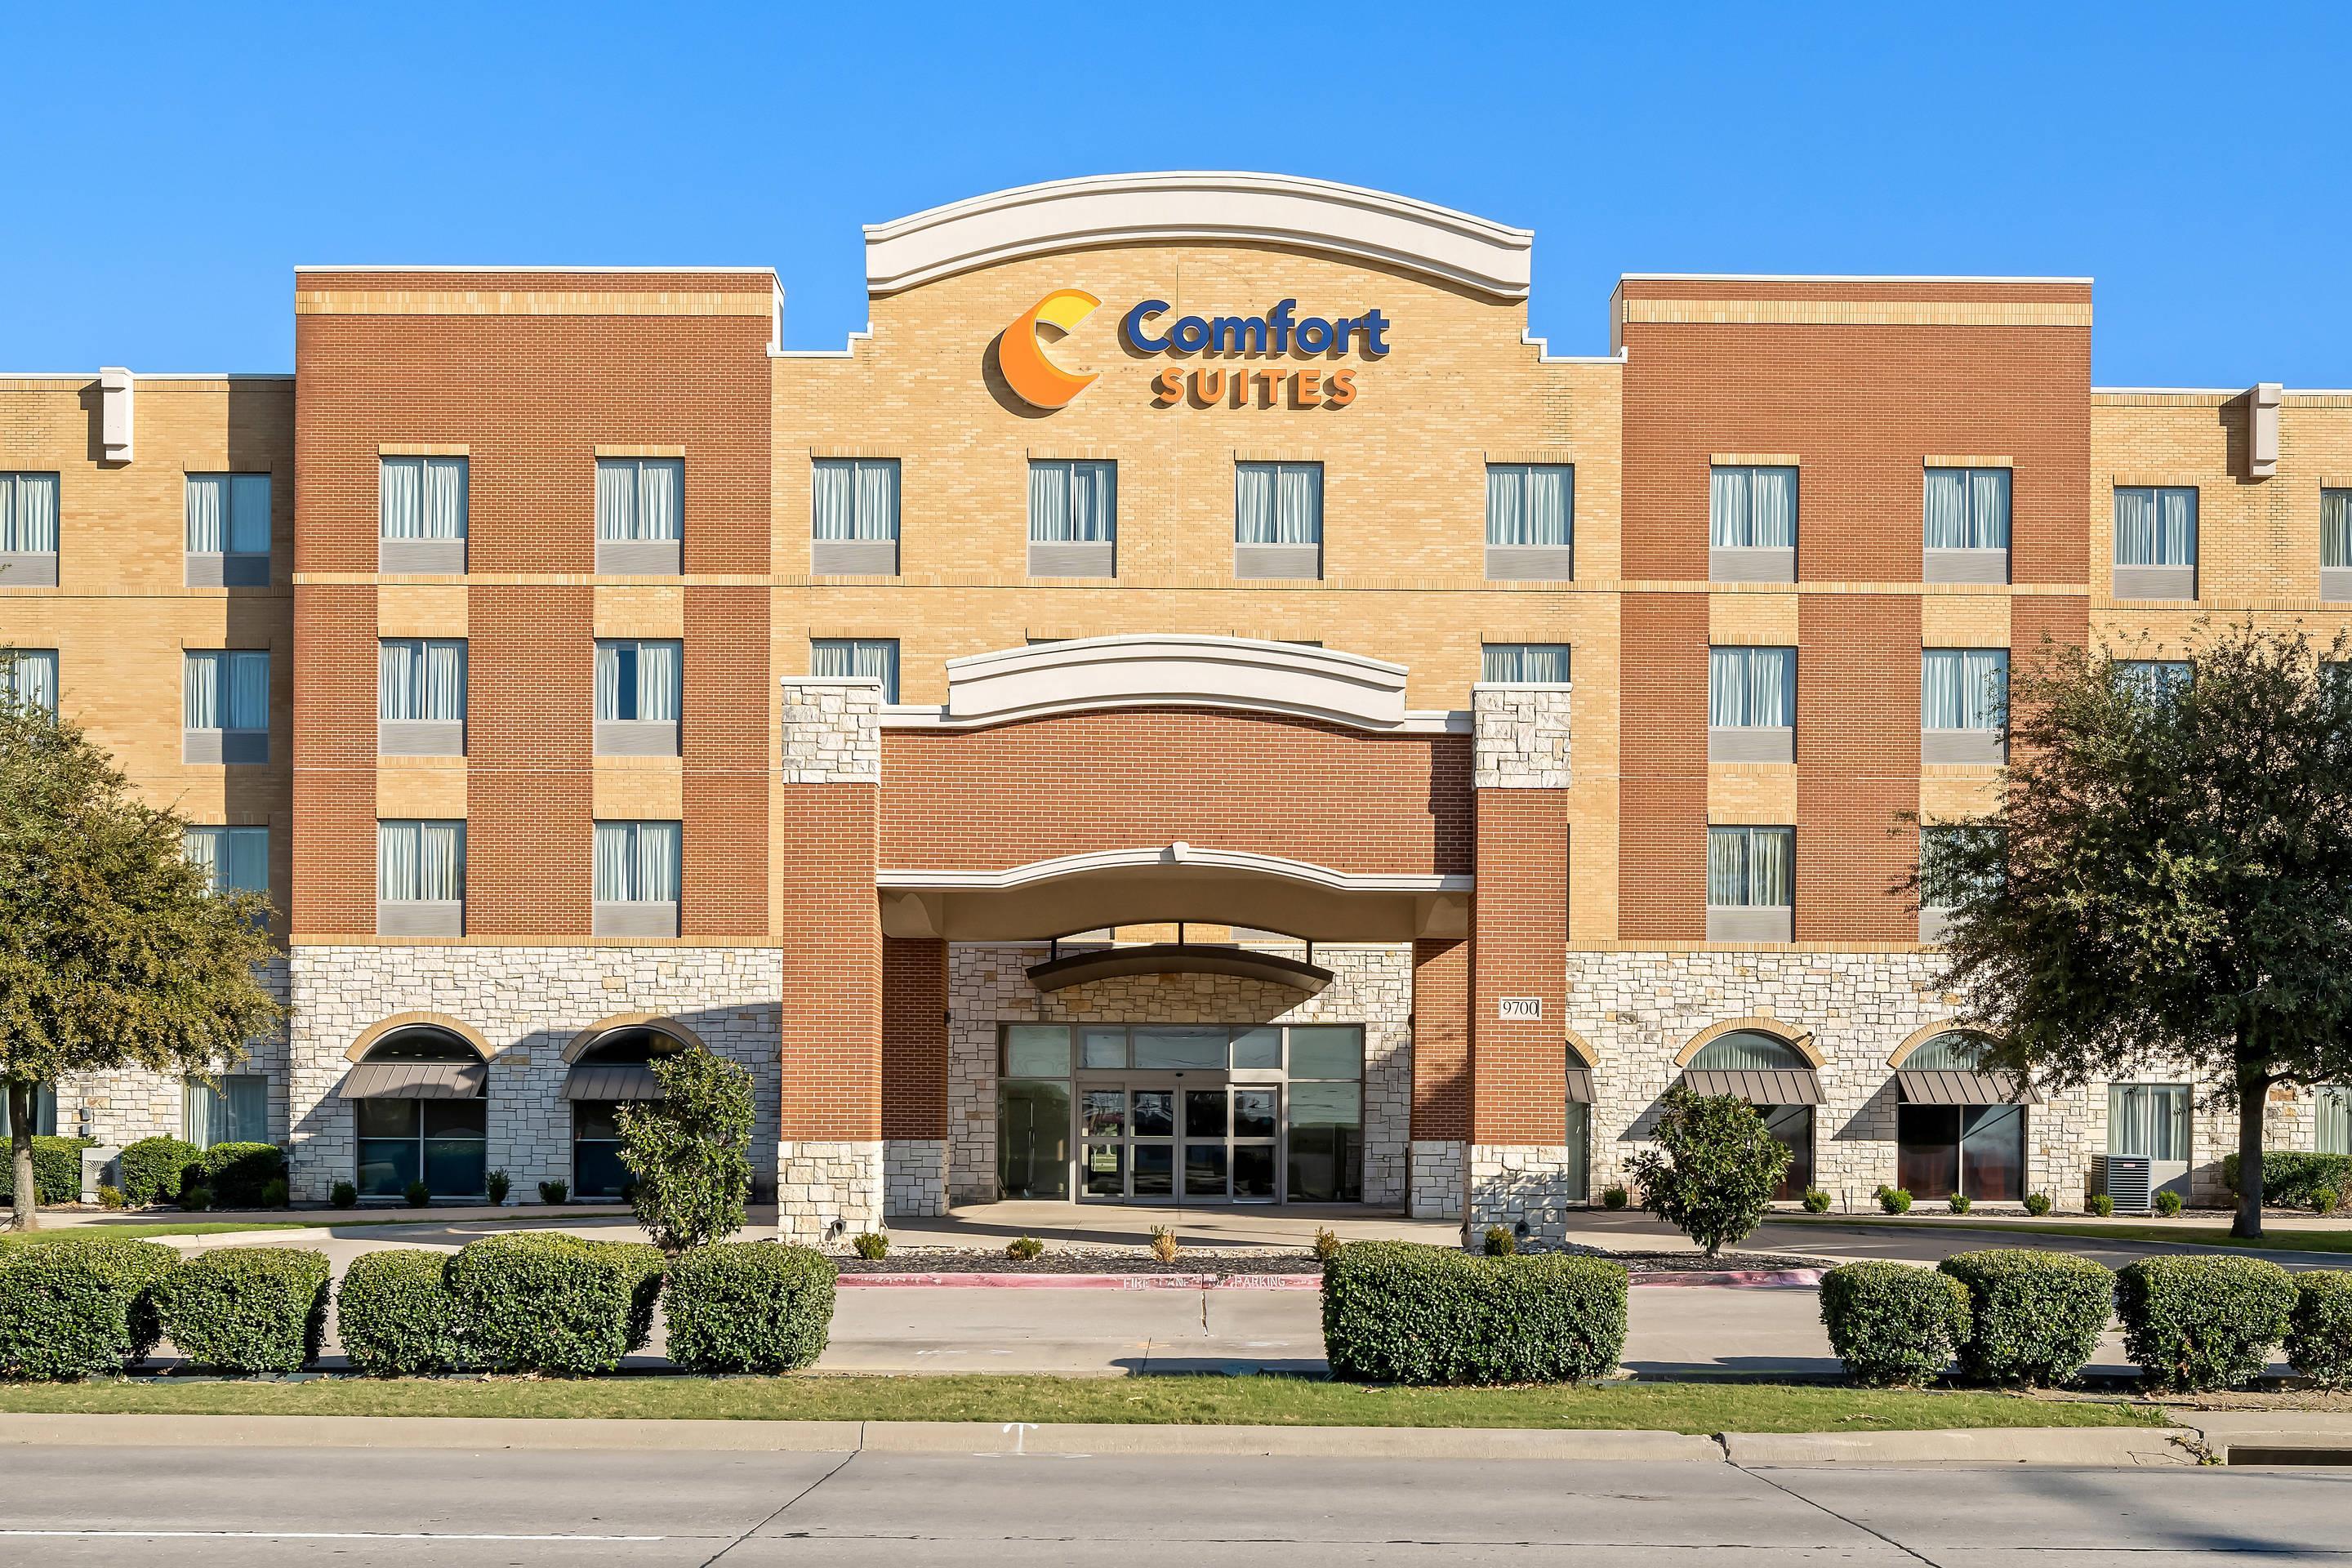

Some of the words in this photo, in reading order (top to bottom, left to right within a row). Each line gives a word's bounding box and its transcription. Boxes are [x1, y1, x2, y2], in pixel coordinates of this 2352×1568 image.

[1127, 298, 1390, 354] Comfort
[1160, 368, 1357, 405] SUITES
[1503, 1001, 1538, 1015] 9700
[1124, 1277, 1150, 1289] FIRE
